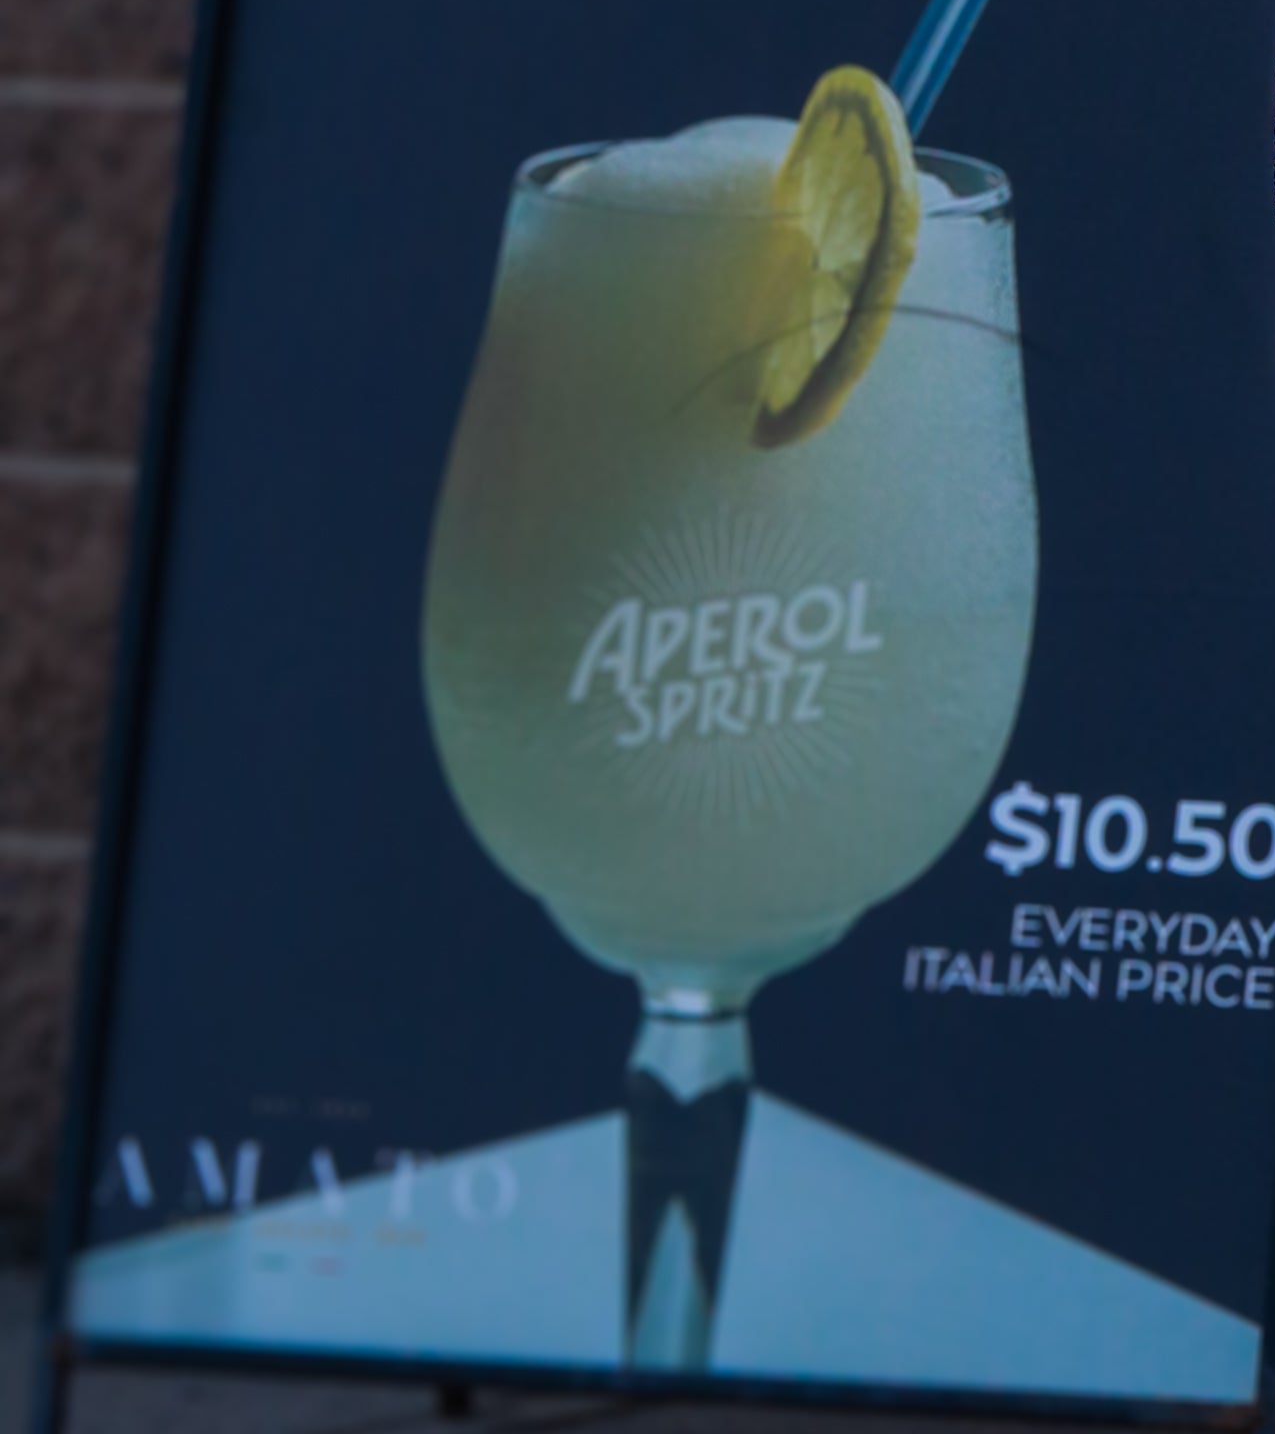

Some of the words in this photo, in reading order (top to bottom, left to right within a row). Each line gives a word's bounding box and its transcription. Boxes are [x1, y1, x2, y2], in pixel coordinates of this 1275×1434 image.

[567, 580, 884, 704] APEROL
[613, 660, 827, 748] SPRITZ
[903, 944, 1101, 1000] ITALIAN
